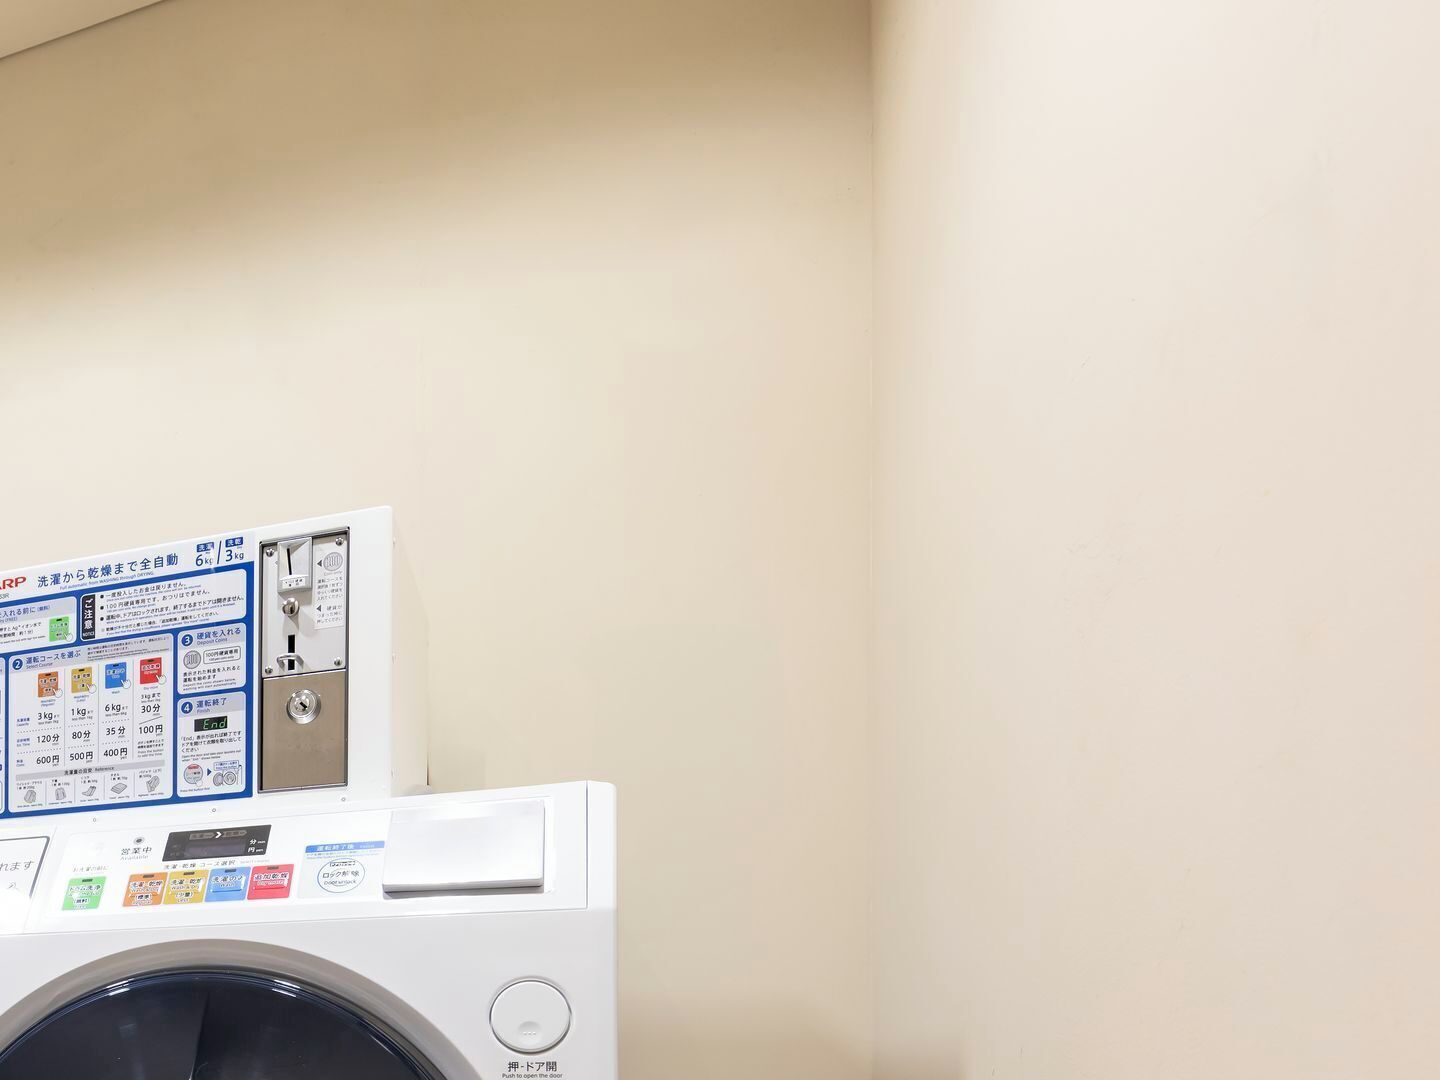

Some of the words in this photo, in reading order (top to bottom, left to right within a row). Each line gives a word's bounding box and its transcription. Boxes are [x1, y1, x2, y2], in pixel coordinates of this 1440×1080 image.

[38, 553, 178, 588] 洗濯から乾燥まで全自動
[84, 598, 93, 629] ご注意
[197, 628, 241, 639] 硬貨を入れる
[185, 636, 190, 644] 3
[26, 650, 81, 664] 運転コースを選ぶ
[15, 660, 20, 669] 2
[196, 698, 226, 708] 運転終了
[141, 704, 160, 713] 30分
[203, 718, 226, 730] End
[139, 724, 163, 734] 100円
[37, 734, 59, 743] 120分
[72, 730, 91, 740] 80分
[70, 752, 93, 761] 500円
[104, 748, 128, 757] 400円
[37, 755, 59, 764] 600円
[121, 846, 152, 855] 営業中
